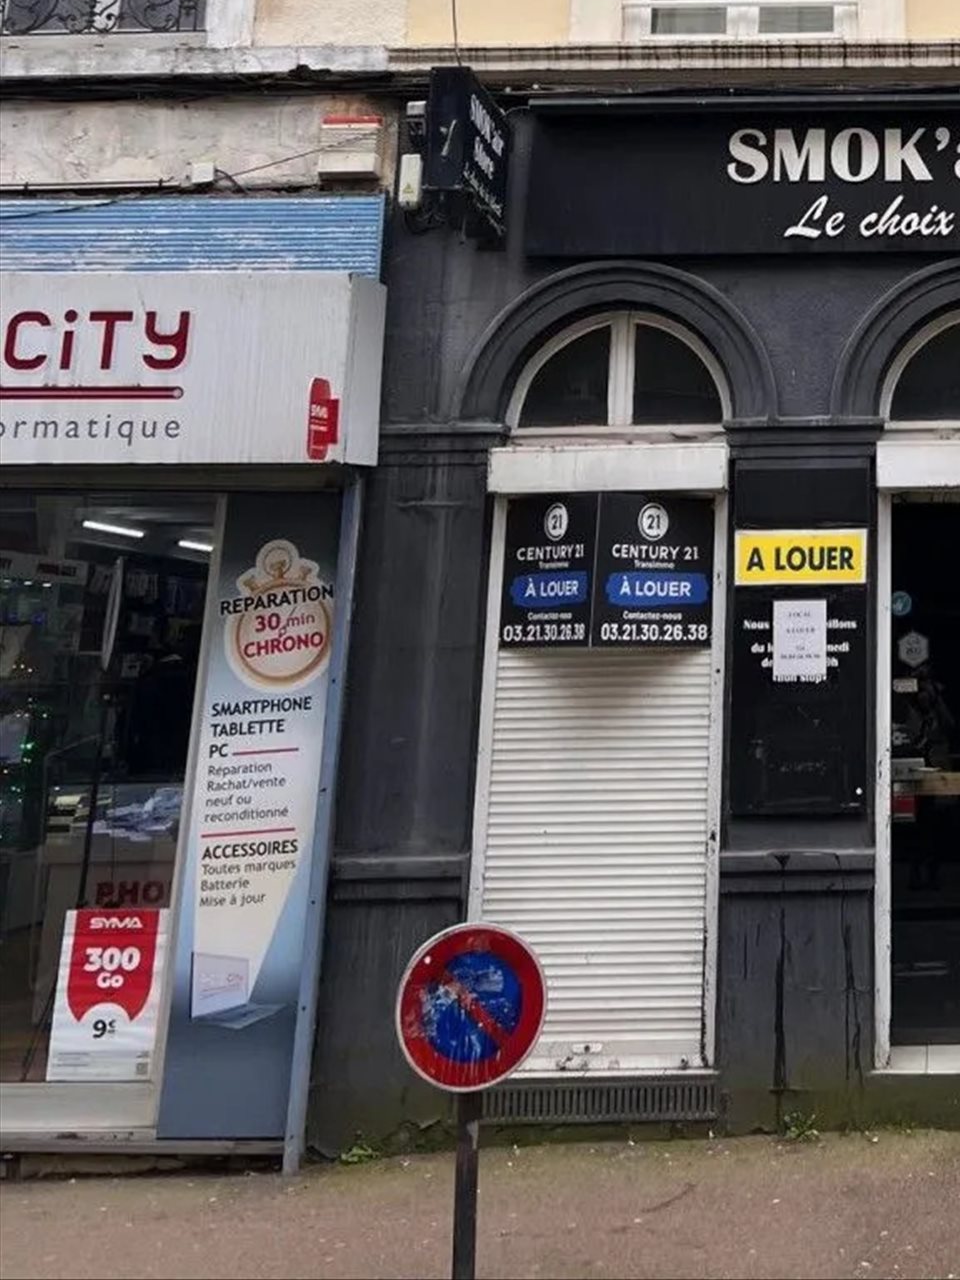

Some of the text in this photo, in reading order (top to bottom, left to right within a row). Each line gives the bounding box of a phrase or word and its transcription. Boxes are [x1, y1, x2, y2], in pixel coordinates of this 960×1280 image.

[785, 194, 845, 238] Le
[859, 195, 955, 237] choix
[516, 543, 585, 561] CENTURY 21
[611, 544, 699, 561] CENTURY 21
[746, 546, 855, 571] A LOUER
[524, 578, 580, 597] À LOUER
[619, 575, 691, 597] À LOUER
[220, 584, 335, 616] REPARATION
[255, 613, 315, 633] 30 min
[622, 610, 683, 621] Contactez-nous
[743, 619, 770, 630] Nous
[503, 623, 586, 642] 03.21.30.26.38
[600, 623, 709, 641] 03.21.30.26.38
[243, 632, 324, 659] CHRONO
[211, 696, 313, 718] SMARTPHONE
[210, 718, 286, 739] TABLETTE
[209, 743, 230, 759] PC
[206, 776, 287, 793] Rachat/vente
[205, 794, 252, 807] neuf ou
[204, 806, 290, 824] reconditionné
[201, 838, 299, 861] ACCESSOIRES
[201, 858, 297, 876] Toutes marques
[200, 877, 250, 892] Batterie
[199, 891, 267, 908] Mise à jour
[89, 916, 144, 930] SYMA
[83, 945, 142, 972] 300
[96, 972, 125, 989] Go
